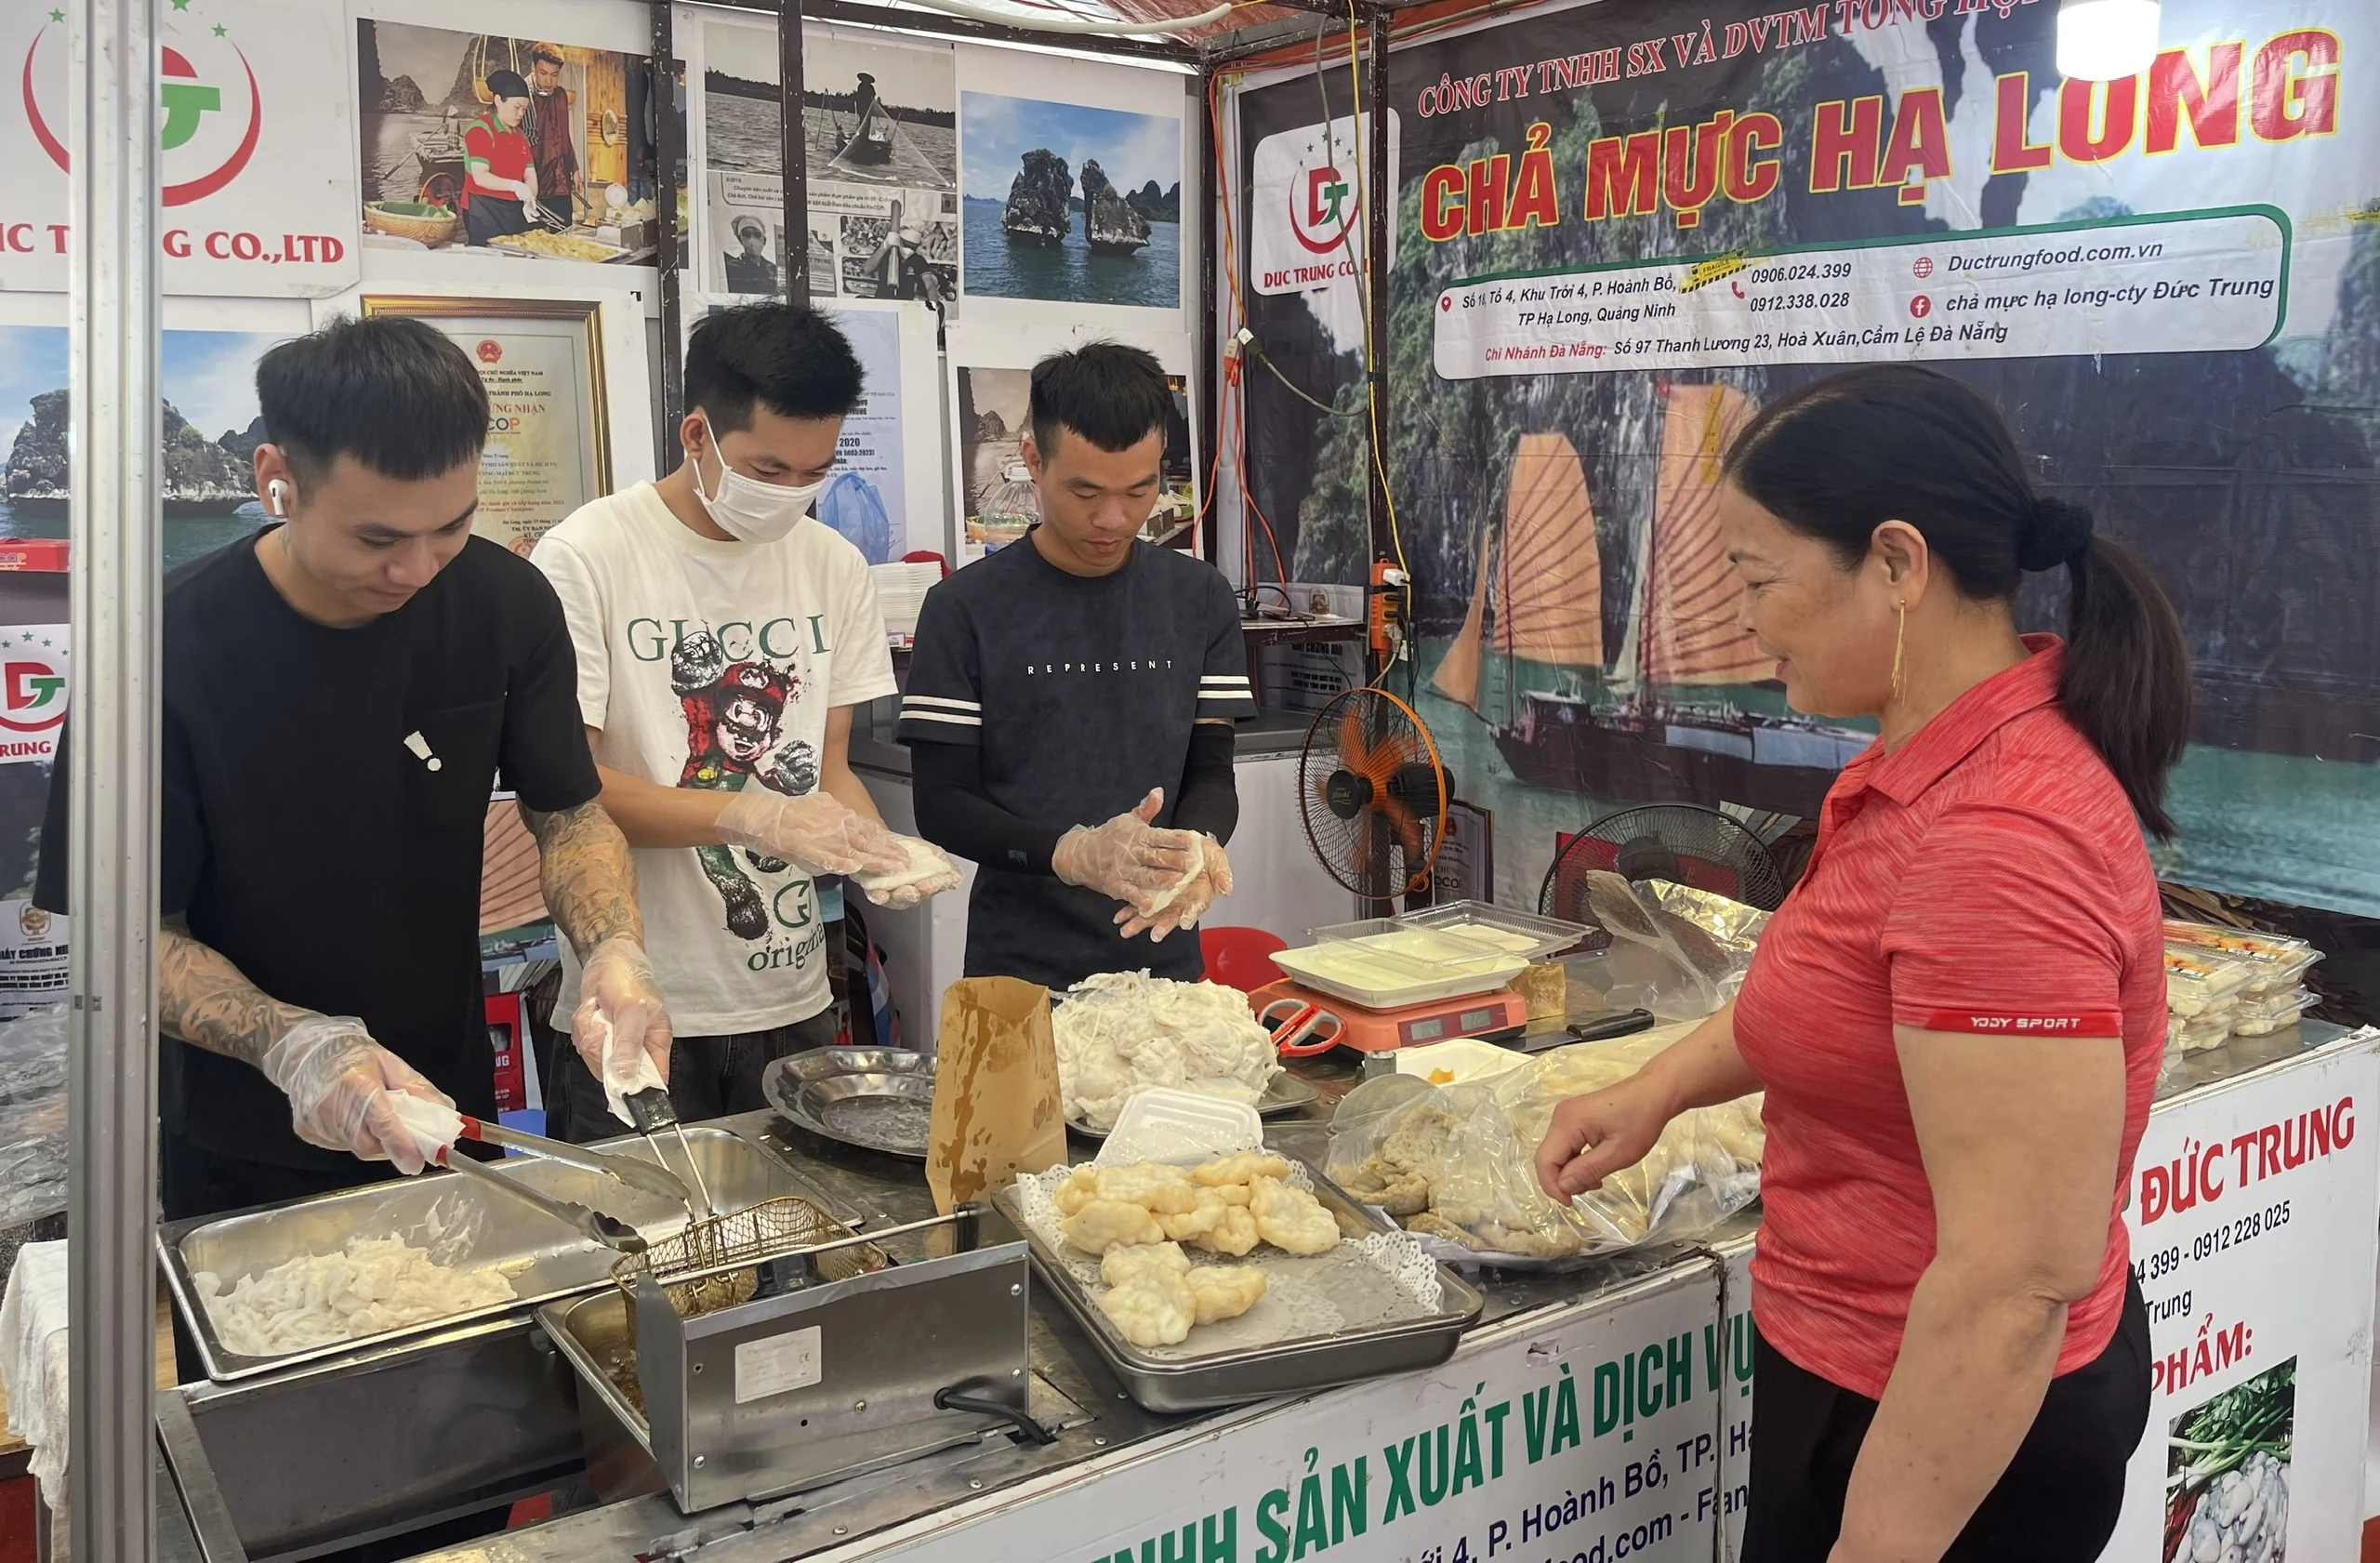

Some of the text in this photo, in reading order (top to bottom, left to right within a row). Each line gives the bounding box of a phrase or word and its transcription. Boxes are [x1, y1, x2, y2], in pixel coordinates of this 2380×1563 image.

[1418, 73, 1491, 119] CÔNG
[1495, 67, 1529, 102] TY
[1539, 46, 1621, 94] TNHH
[1626, 37, 1666, 78] SX
[1672, 20, 1717, 69] VÀ
[1723, 2, 1828, 59] DVTM
[1421, 28, 2342, 242] CHẢ MỰC HẠ LONG
[205, 232, 344, 264] CO.,LTD
[1948, 242, 2163, 272] Ductrungfood.com.vn
[1264, 271, 1290, 287] DUC
[1293, 263, 1335, 284] TRUNG
[1752, 263, 1852, 285] 0906.024.399
[1462, 291, 1476, 309] Số
[1489, 287, 1502, 304] Tổ
[1505, 289, 1515, 304] 4,
[1520, 288, 1546, 301] Khu
[1549, 283, 1576, 300] Trới
[1578, 283, 1590, 299] 4,
[1592, 281, 1606, 296] P.
[1606, 276, 1650, 295] Hoành
[1750, 292, 1850, 313] 0912.338.028
[1946, 276, 2275, 312] chả mực hạ long-cty Đức Trung
[1518, 302, 1676, 327] TP Hạ Long, Quảng Ninh
[1485, 346, 1502, 361] Chi
[1504, 346, 1546, 360] Nhánh
[1549, 343, 1567, 358] Đà
[1614, 338, 1633, 355] Số
[1634, 340, 1653, 354] 97
[1656, 338, 1701, 353] Thanh
[1703, 335, 1752, 353] Lương
[1753, 333, 1773, 351] 23,
[1777, 331, 1808, 348] Hoà
[1905, 325, 1924, 348] Lệ
[1930, 325, 1953, 342] Đà
[1959, 319, 2008, 343] Nẵng
[840, 438, 860, 447] 2020
[1027, 660, 1172, 675] REPRESENT
[0, 740, 52, 757] RUNG
[747, 922, 826, 971] origina
[2016, 1018, 2081, 1028] SPORT
[2141, 1096, 2355, 1225] ĐỨC TRUNG
[2150, 1246, 2179, 1280] 399
[2193, 1225, 2230, 1262] 0912
[2234, 1212, 2261, 1246] 228
[2265, 1199, 2290, 1232] 025
[2146, 1290, 2192, 1324] Trung
[1255, 1446, 1368, 1563] SẢN
[1382, 1381, 1511, 1526] XUẤT
[1523, 1362, 1580, 1465] VÀ
[1593, 1331, 1692, 1444] DỊCH
[1489, 1519, 1512, 1557] P.
[1522, 1477, 1615, 1543] Hoành
[1624, 1448, 1669, 1499] Bồ,
[1676, 1433, 1715, 1473] TP.
[1698, 1485, 1749, 1522] Fan
